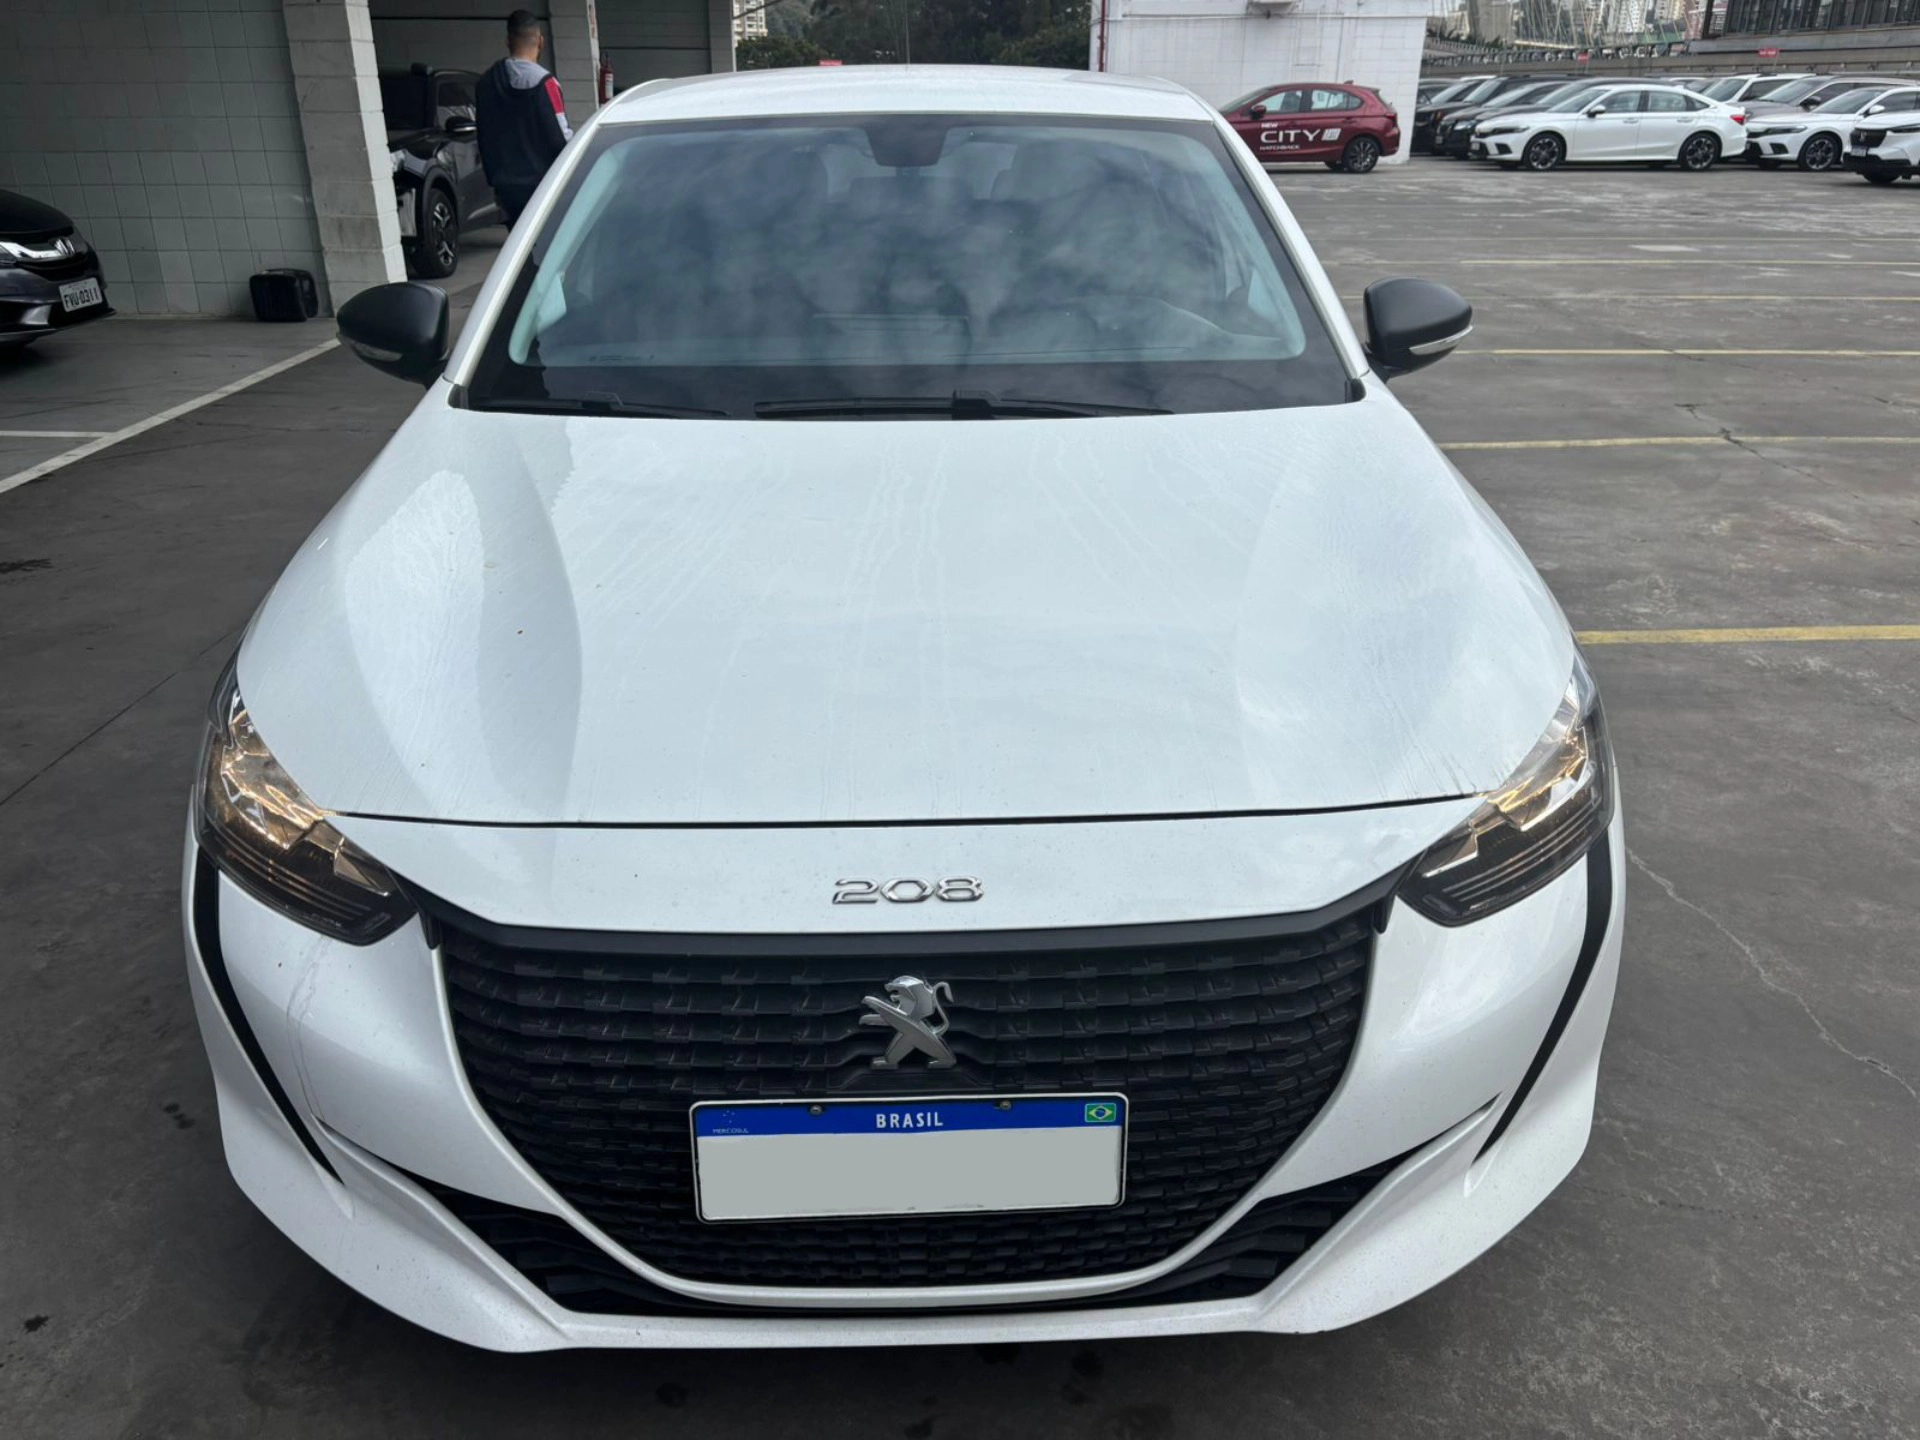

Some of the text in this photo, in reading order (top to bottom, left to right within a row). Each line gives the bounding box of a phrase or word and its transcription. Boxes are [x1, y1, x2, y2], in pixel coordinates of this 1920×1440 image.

[1260, 129, 1320, 143] CITY
[832, 877, 984, 904] 208
[876, 1111, 943, 1128] BRASIL
